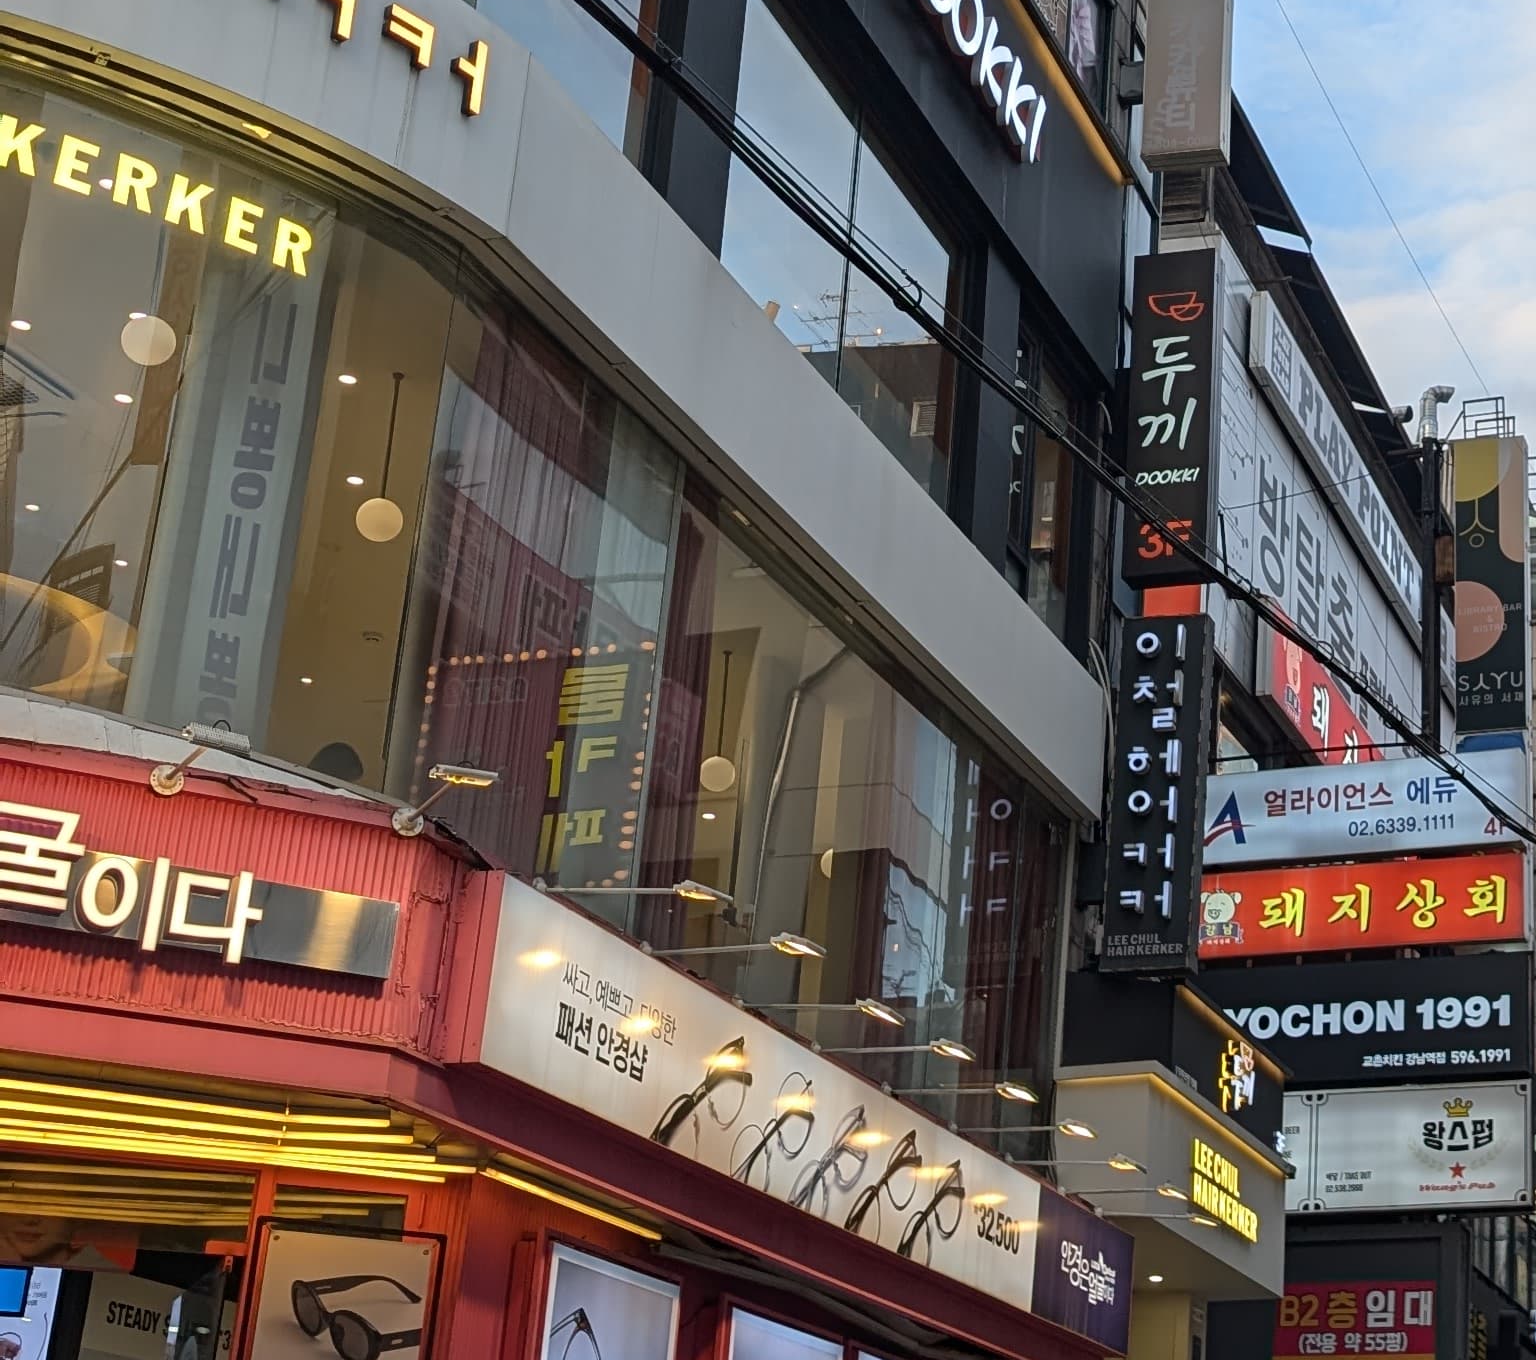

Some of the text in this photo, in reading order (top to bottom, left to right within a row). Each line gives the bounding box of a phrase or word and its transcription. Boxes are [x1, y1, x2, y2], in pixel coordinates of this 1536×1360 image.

[1137, 335, 1197, 451] 두끼
[1134, 467, 1200, 487] DOOKKI
[1299, 367, 1355, 503] PLAY
[1358, 470, 1416, 610] POINT
[1138, 520, 1193, 561] 3F
[1502, 603, 1523, 612] BAR
[1459, 695, 1494, 706] 사유의
[1264, 776, 1458, 818] 얼라이언스 에듀
[1348, 813, 1455, 838] 02.6339.1111
[1258, 875, 1507, 938] 돼지상회
[1108, 934, 1162, 947] LEE CHUL
[1416, 994, 1512, 1030] 1991
[554, 1000, 649, 1083] 패션 안경샵
[1361, 1048, 1512, 1068] 교촌치킨 강남역점 596.1991
[1421, 1118, 1495, 1152] 왕스펍
[1193, 1139, 1241, 1198] LEE CHUL
[106, 1300, 162, 1334] STEADY
[1297, 1330, 1408, 1354] (전용 약 55평)
